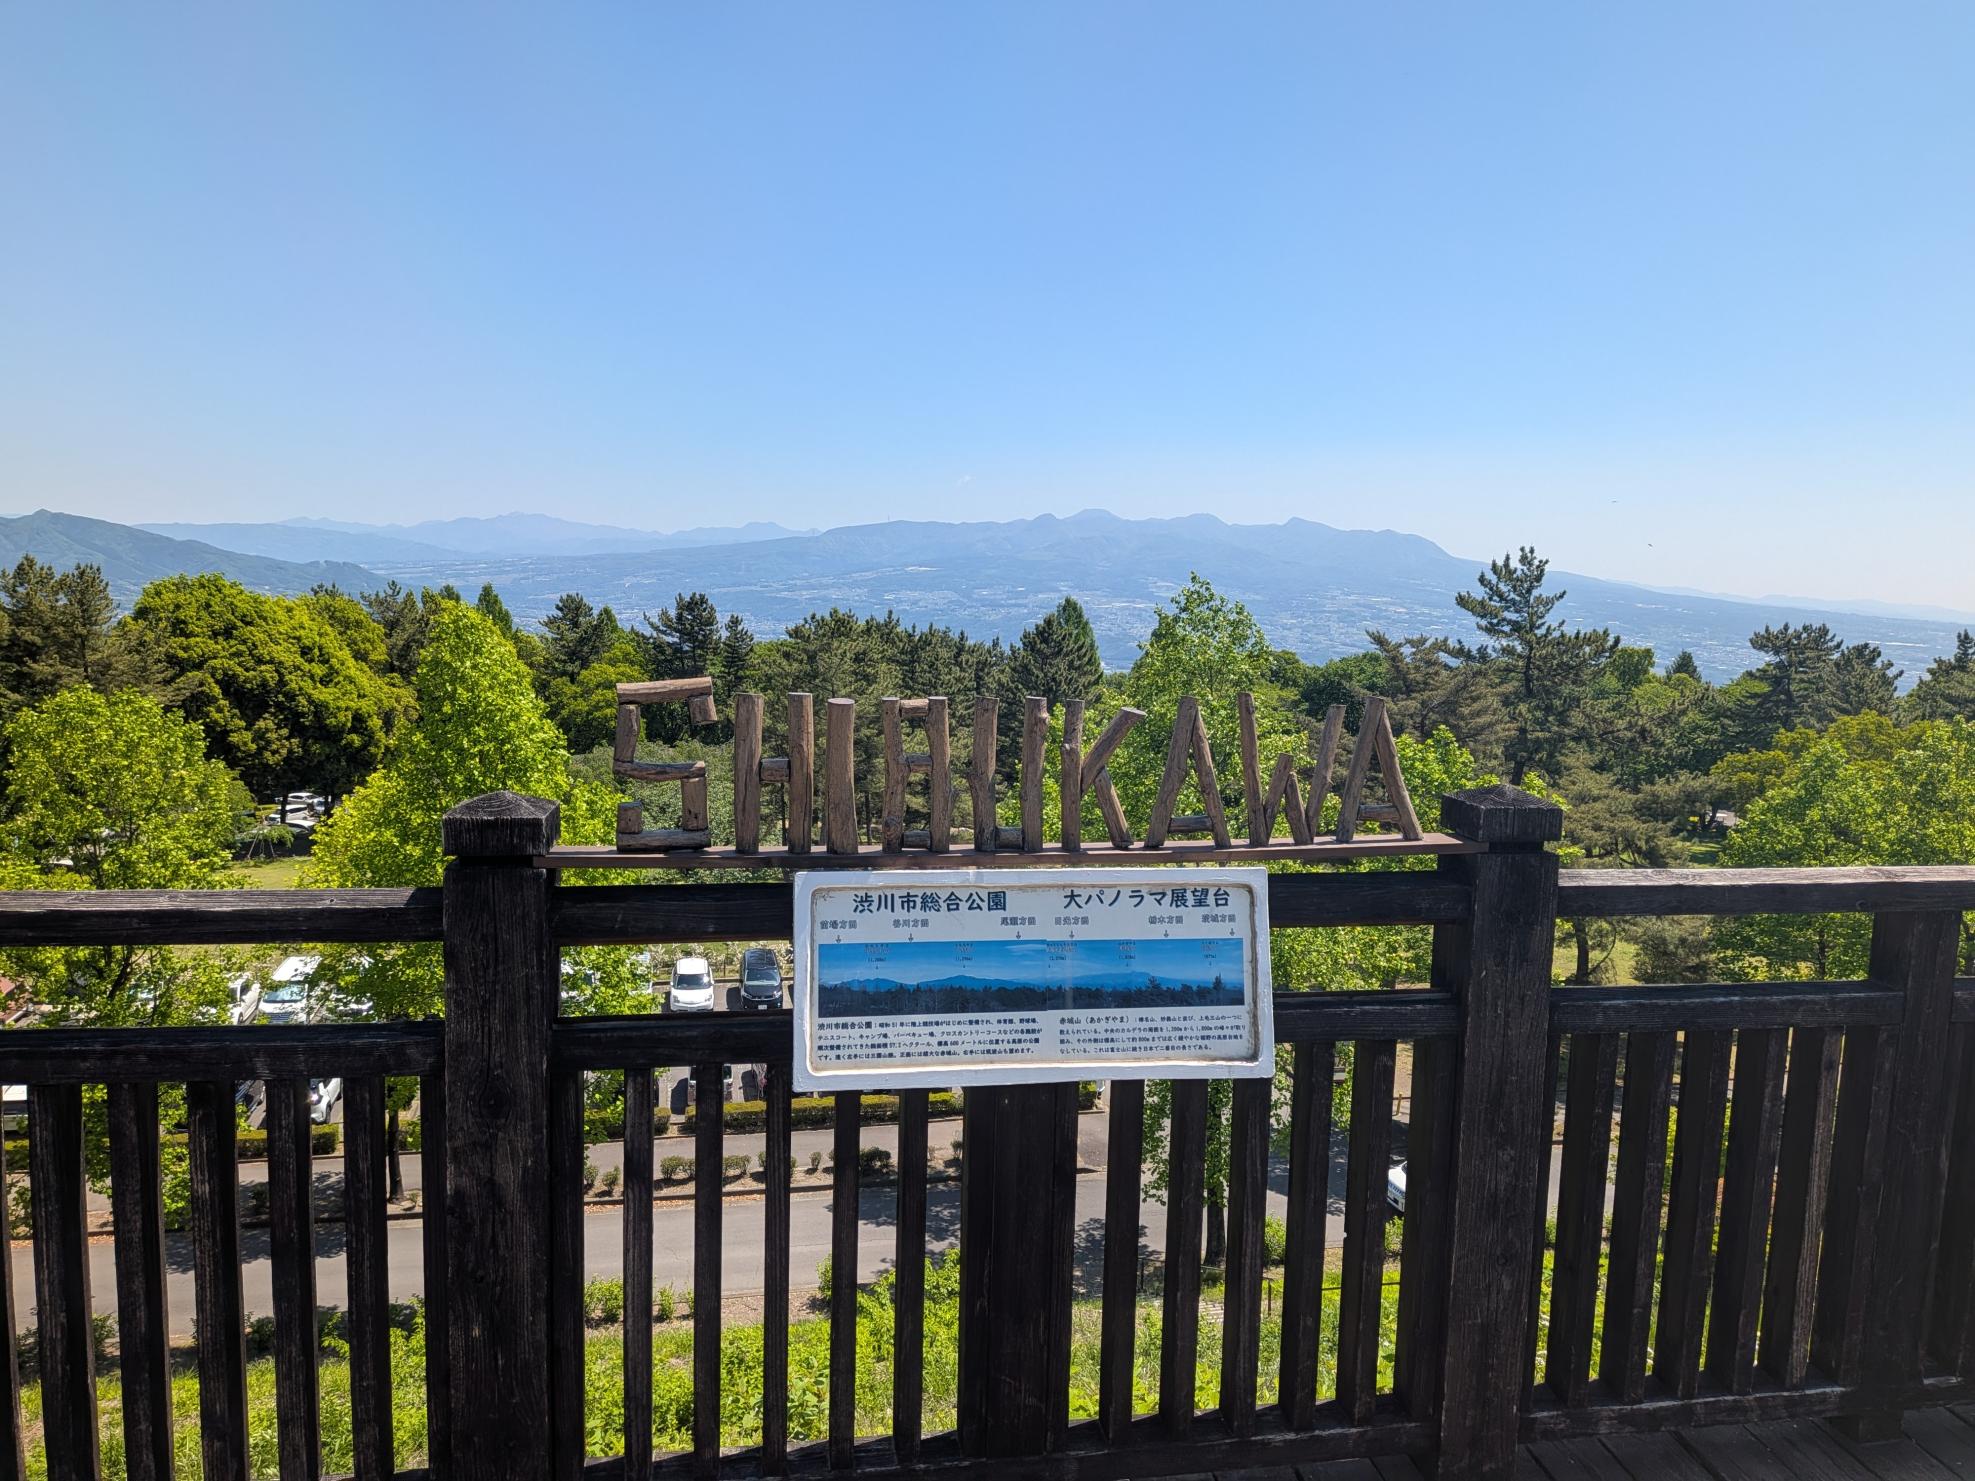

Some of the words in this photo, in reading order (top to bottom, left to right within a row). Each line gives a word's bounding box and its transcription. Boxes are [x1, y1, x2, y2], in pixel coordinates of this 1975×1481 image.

[613, 676, 1423, 855] SHIBUKAWA
[852, 890, 1007, 914] 渋川市総合公園
[1063, 887, 1231, 909] 大パノラマ展望台
